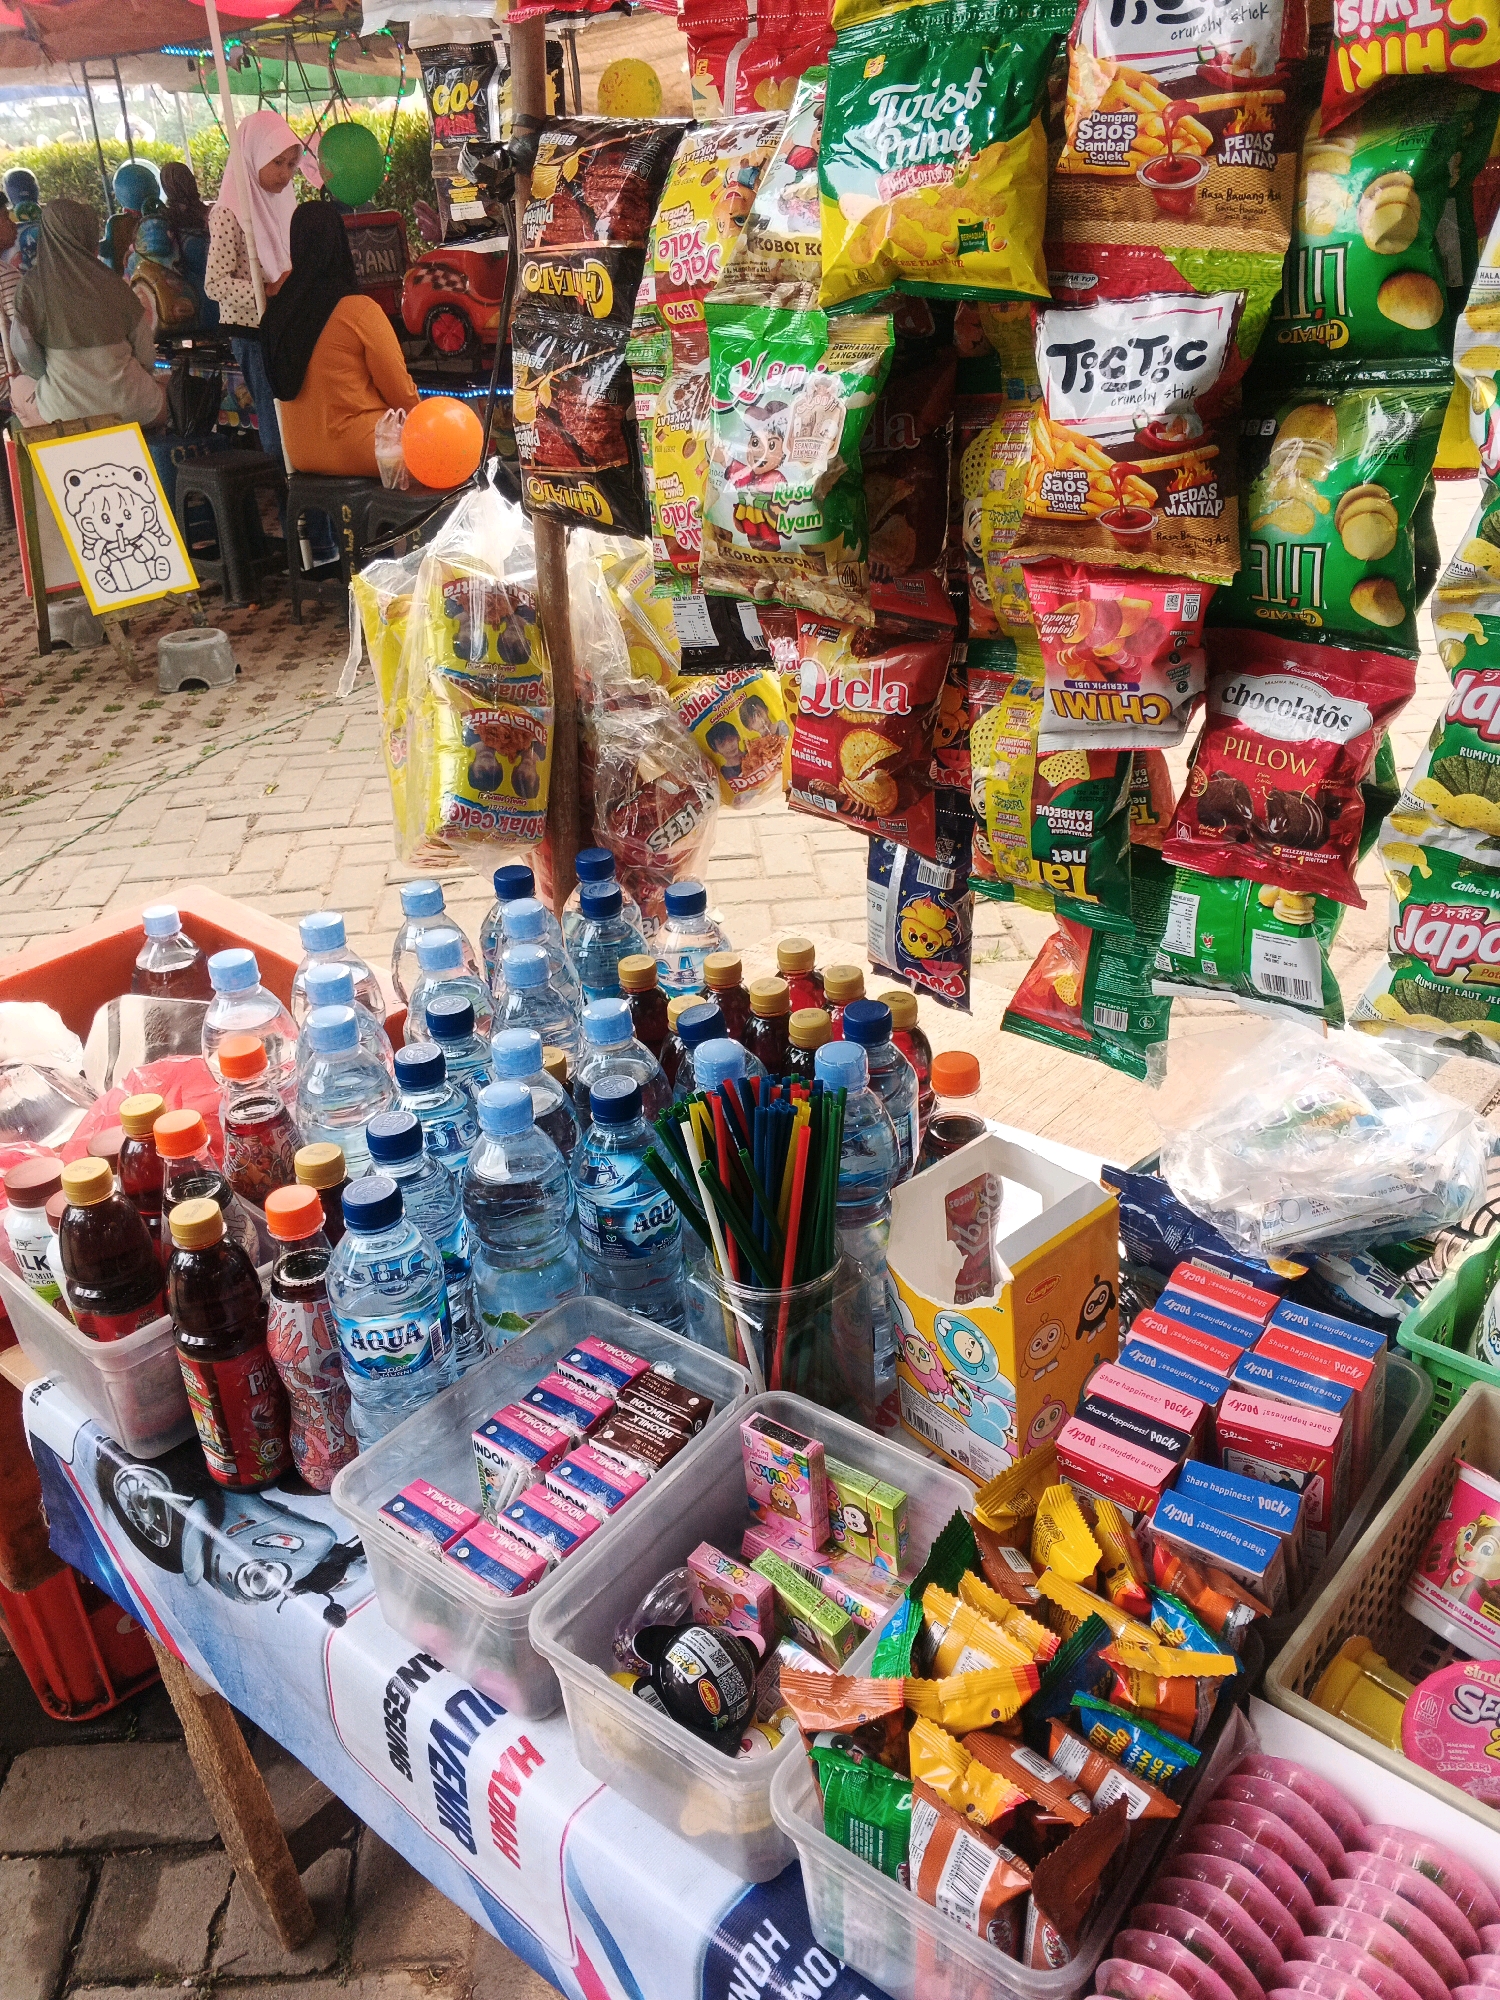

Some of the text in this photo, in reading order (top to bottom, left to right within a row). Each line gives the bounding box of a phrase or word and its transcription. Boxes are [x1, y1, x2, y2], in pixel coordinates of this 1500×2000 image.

[1171, 17, 1223, 42] crunchy
[1230, 4, 1270, 25] stick
[433, 80, 479, 116] GO!
[866, 67, 987, 139] Twist
[1092, 112, 1137, 124] Dengan
[1077, 120, 1136, 140] Saos
[878, 123, 973, 174] Prime
[1075, 139, 1130, 152] Sambal
[1224, 132, 1275, 152] PEDAS
[682, 141, 719, 165] COKELAT
[1089, 151, 1123, 161] Colek
[1218, 150, 1277, 170] MANTAP
[1201, 188, 1264, 203] Rasa Bawang
[658, 222, 709, 261] Yale
[670, 246, 722, 286] Yale
[666, 302, 699, 319] 15%
[829, 352, 875, 360] LANGSUNG
[1111, 382, 1199, 408] crunchy stick
[656, 408, 693, 429] COKELAT
[670, 419, 692, 432] Rasa
[1043, 471, 1089, 494] Saos
[1041, 490, 1085, 503] Sambal
[1170, 483, 1218, 505] PEDAS
[1052, 501, 1080, 511] Colek
[1165, 499, 1223, 518] MANTAP
[777, 510, 823, 537] Ayam
[800, 623, 817, 636] #1
[1041, 612, 1080, 626] Balado
[1041, 623, 1078, 643] Jagung
[799, 658, 911, 717] Qtela
[1074, 681, 1129, 692] KERIPIK UBI
[679, 684, 721, 728] eblak
[1051, 689, 1174, 726] CHIMI
[462, 709, 545, 744] Dua Putra
[791, 747, 833, 769] BARBEQUE
[1223, 736, 1318, 778] PILLOW
[736, 768, 766, 790] Dua
[1036, 804, 1094, 821] BARBECUE
[1047, 818, 1093, 832] POTATO
[1052, 828, 1093, 838] PETUALANGAN
[1051, 849, 1087, 864] net
[1272, 845, 1281, 857] 3
[1298, 854, 1304, 866] 1
[1451, 880, 1490, 898] Calbee
[1430, 903, 1485, 922] ジャポタ
[1414, 973, 1481, 1001] RUMPUT LAUT
[949, 1190, 975, 1209] SOSRO
[632, 1199, 678, 1235] AQU
[12, 1250, 51, 1271] ILK
[955, 1286, 989, 1303] GINAL
[1208, 1280, 1248, 1299] happiness!
[1247, 1295, 1268, 1308] Share
[1193, 1311, 1233, 1331] happiness!
[1311, 1321, 1352, 1341] happiness!
[350, 1319, 424, 1353] AQUA
[1170, 1331, 1209, 1352] happiness!
[1233, 1327, 1254, 1339] Share
[1352, 1336, 1375, 1348] Share
[595, 1340, 637, 1364] INDOMILK
[1209, 1348, 1230, 1361] Share
[1268, 1338, 1289, 1352] Share
[1290, 1345, 1331, 1366] happiness!
[1159, 1363, 1199, 1384] happiness!
[559, 1378, 601, 1402] INDOMILK
[1100, 1374, 1120, 1387] Share
[1121, 1382, 1162, 1404] happiness!
[1199, 1380, 1220, 1394] Share
[1276, 1374, 1318, 1396] happiness!
[1318, 1388, 1342, 1402] Share
[630, 1396, 675, 1423] INDOMILK
[1086, 1403, 1108, 1419] Share
[1108, 1413, 1149, 1436] happiness!
[1263, 1409, 1307, 1427] happiness!
[514, 1410, 557, 1437] INDOMILK
[632, 1414, 674, 1440] INDOMILK
[1309, 1421, 1333, 1434] Share
[1099, 1442, 1139, 1465] happiness!
[1264, 1438, 1284, 1449] OPEN
[589, 1452, 632, 1478] INDOMILK
[1140, 1460, 1163, 1474] Share
[1185, 1475, 1208, 1489] Share
[1209, 1482, 1255, 1504] happiness!
[423, 1487, 466, 1516] INDOMILK
[542, 1492, 585, 1521] INDOMILK
[490, 1530, 533, 1561] INDOMILK
[1198, 1520, 1267, 1558] Share happiness!
[427, 1686, 508, 1855] UVENIR
[487, 1734, 547, 1870] HADIAH
